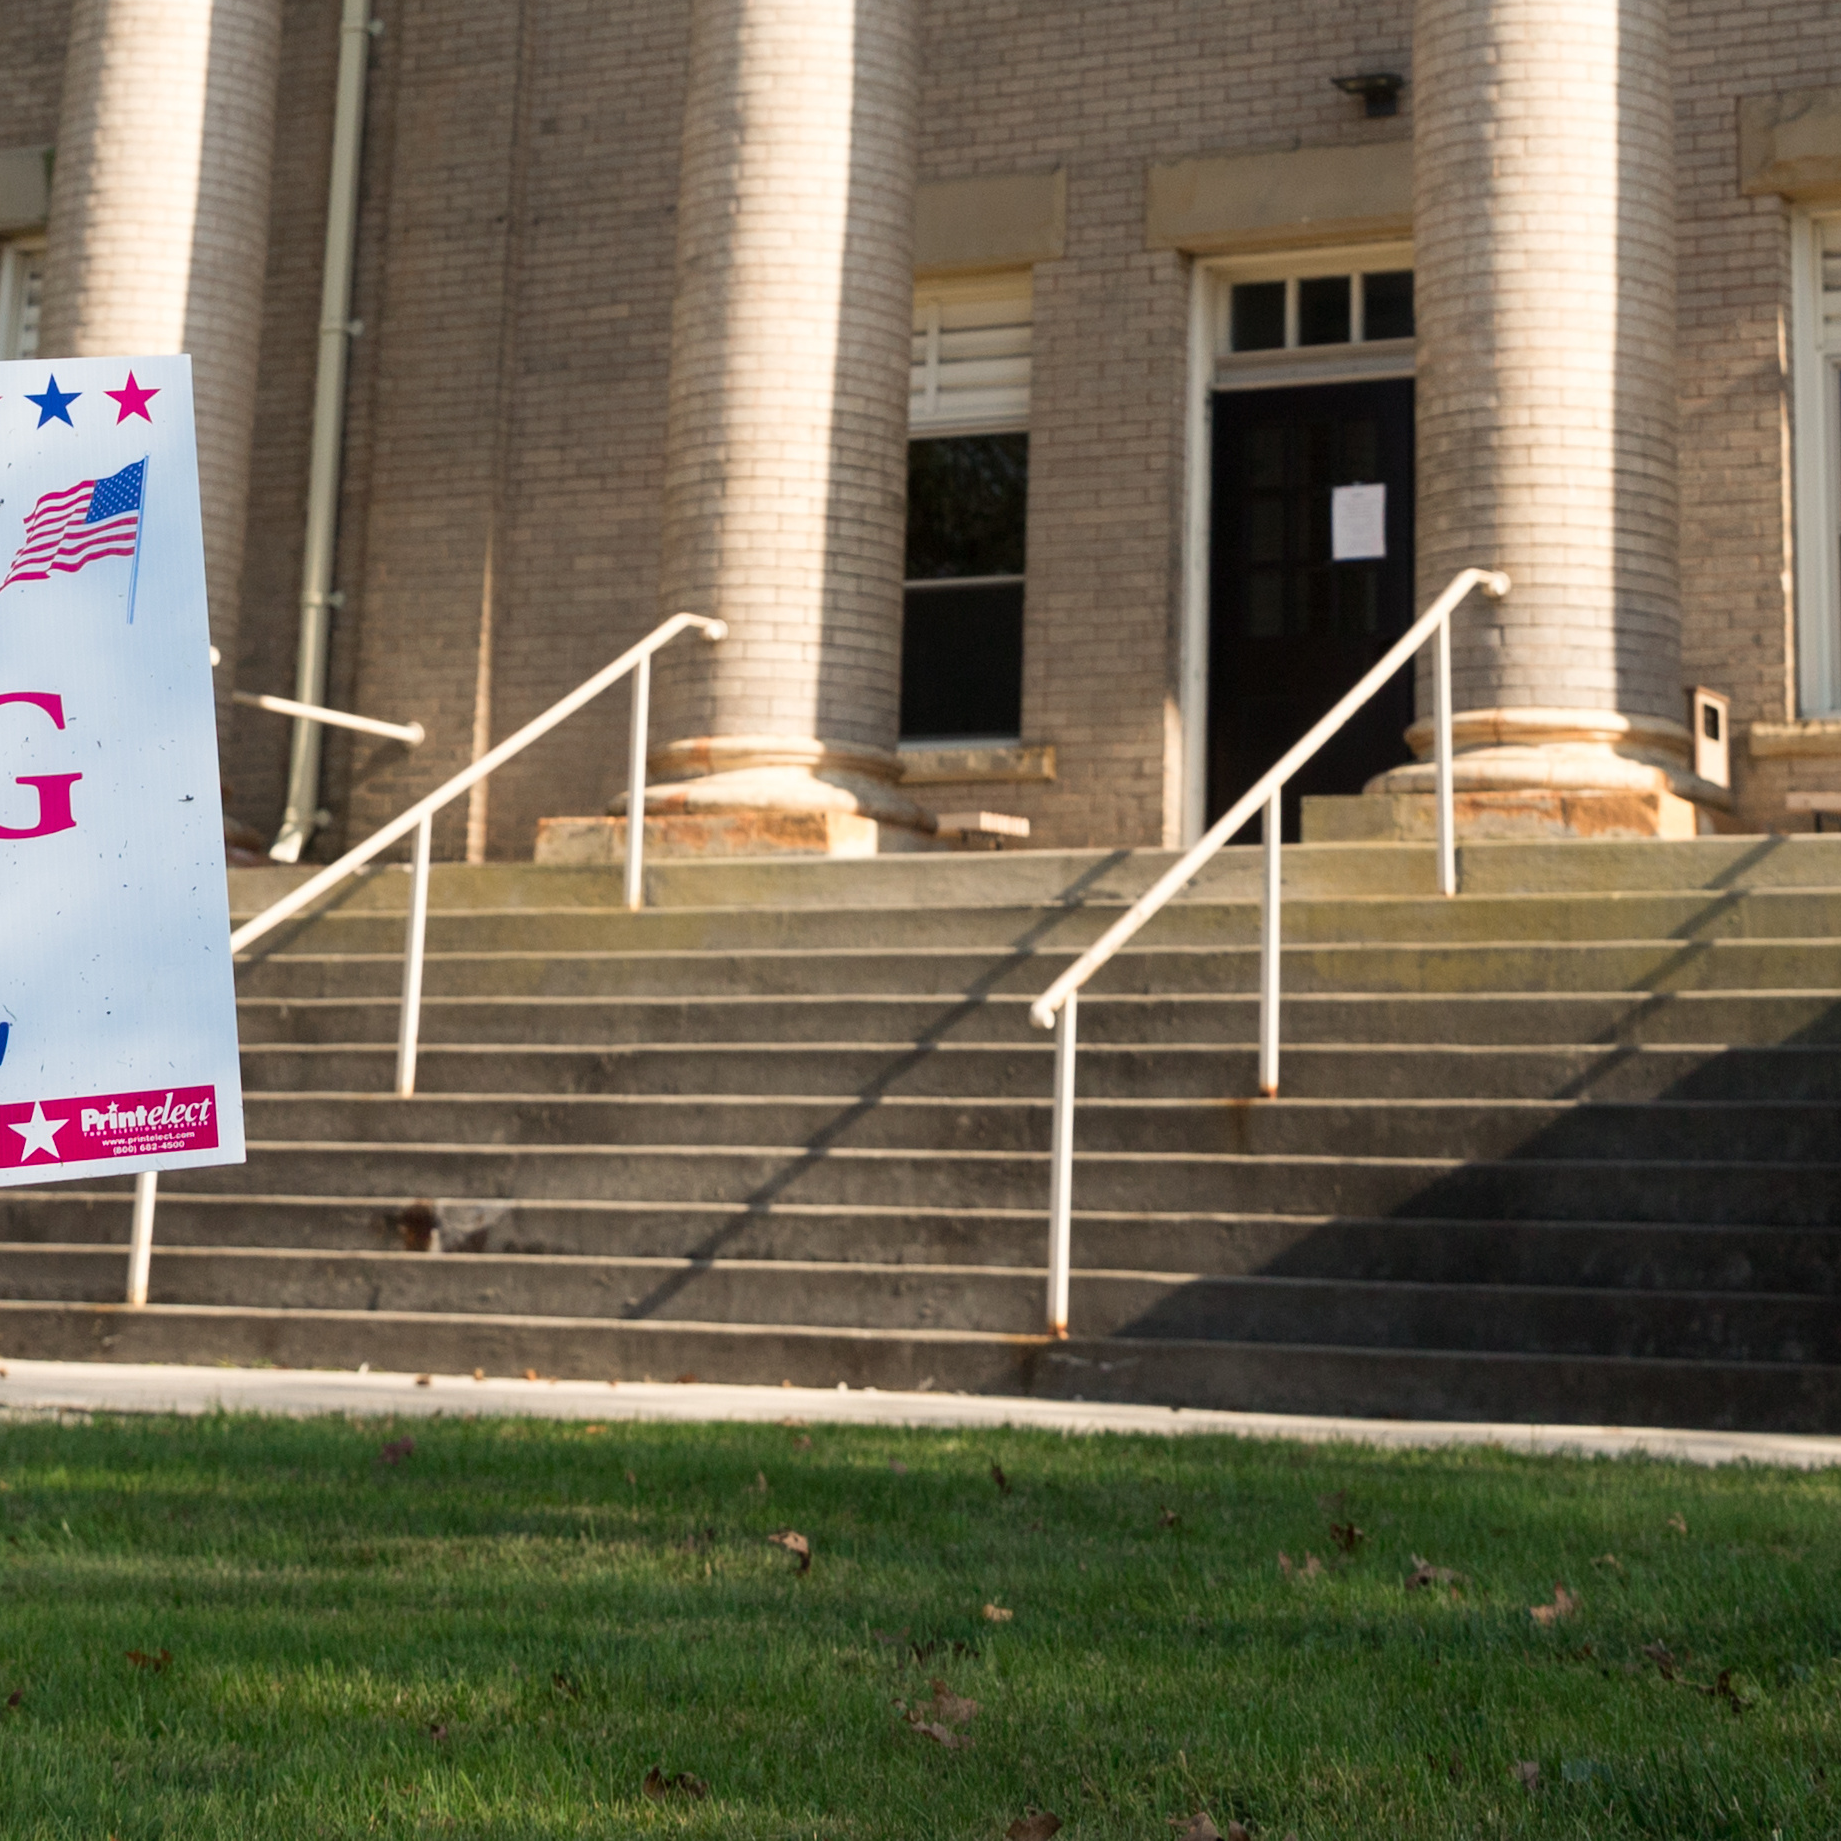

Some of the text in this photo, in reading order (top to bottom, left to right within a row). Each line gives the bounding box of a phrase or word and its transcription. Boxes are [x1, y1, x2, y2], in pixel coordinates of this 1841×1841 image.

[81, 1092, 213, 1132] Printelect
[102, 1131, 195, 1146] www.printelect.com
[113, 1140, 185, 1155] (800) 682-4500
